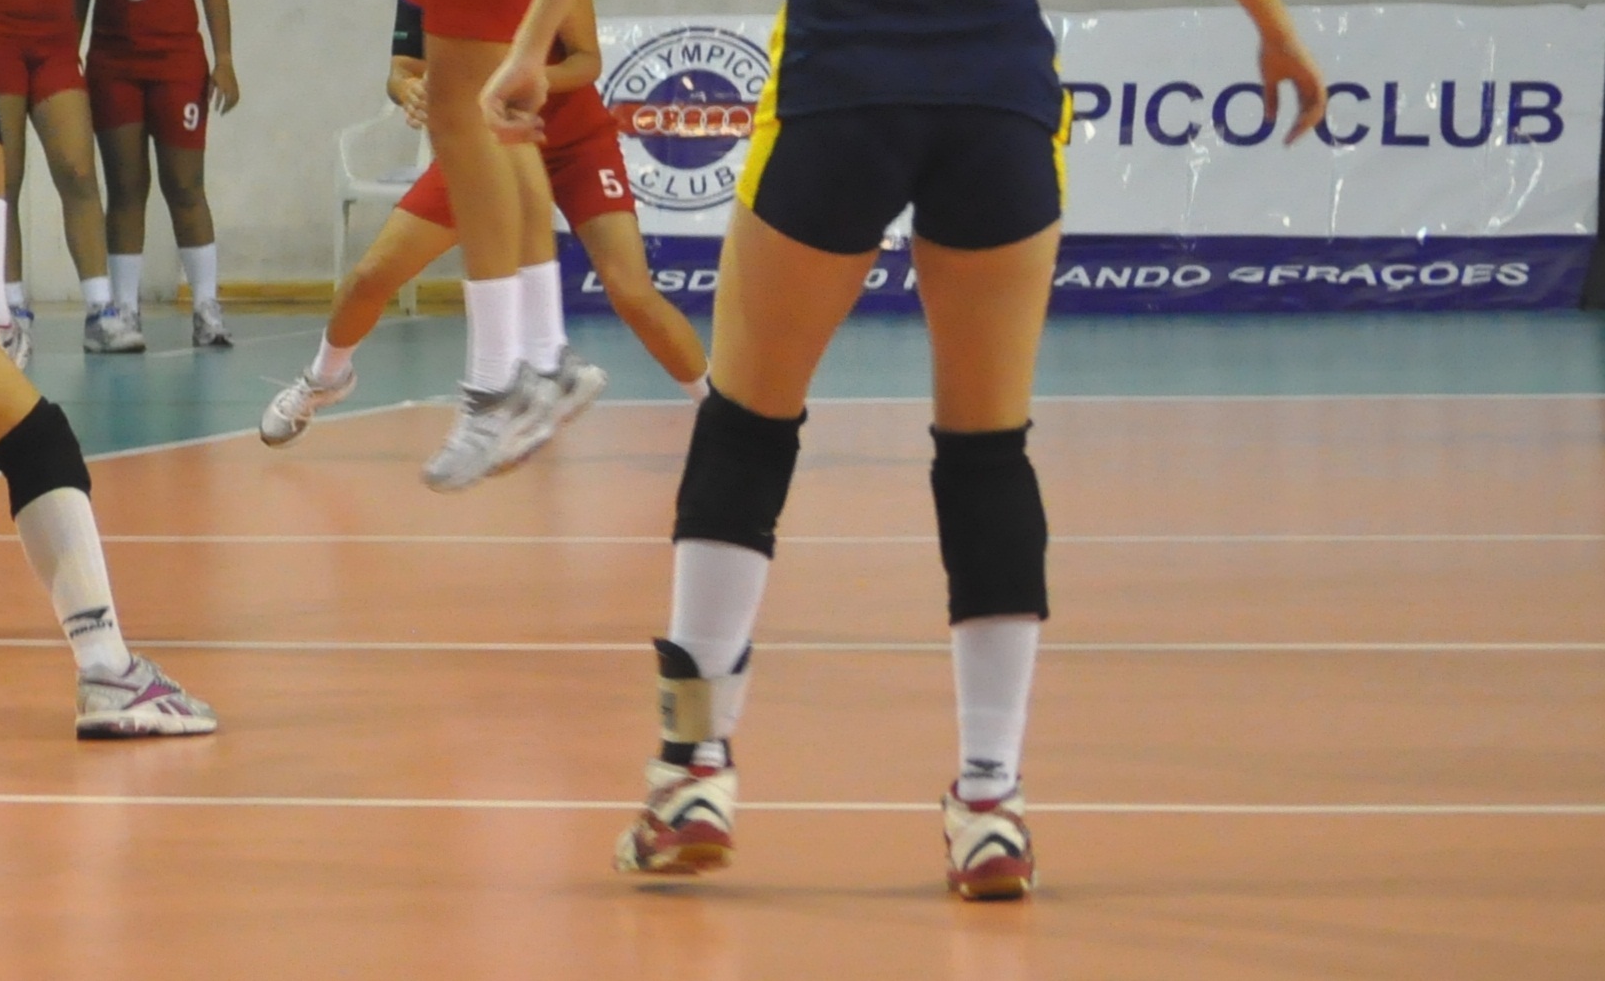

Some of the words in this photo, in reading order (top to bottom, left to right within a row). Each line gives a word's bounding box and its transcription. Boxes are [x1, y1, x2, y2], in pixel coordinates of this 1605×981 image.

[182, 102, 200, 131] 9
[1066, 80, 1272, 147] PICO
[1314, 80, 1565, 148] CLUB
[598, 168, 625, 199] 5
[640, 166, 737, 198] CLUB
